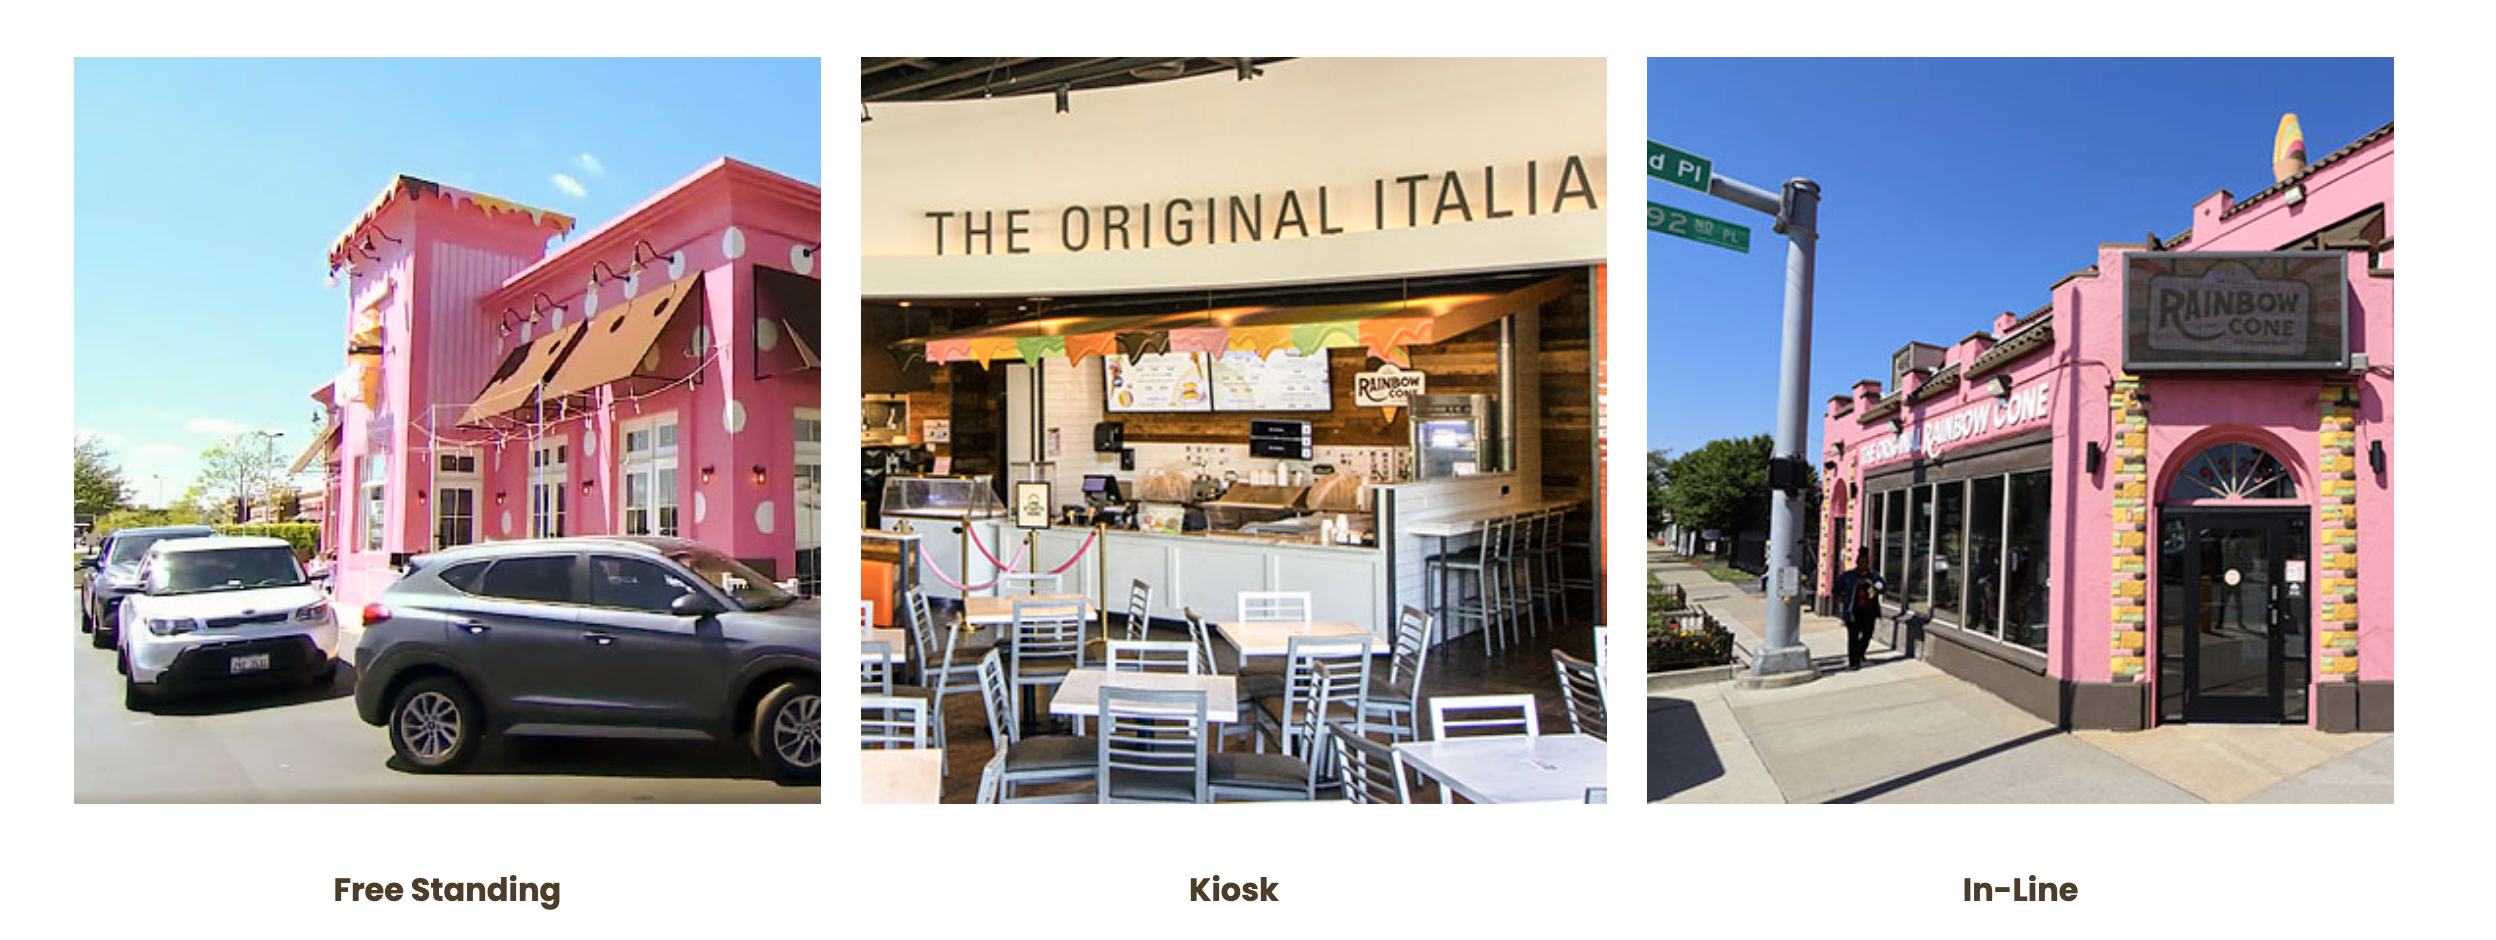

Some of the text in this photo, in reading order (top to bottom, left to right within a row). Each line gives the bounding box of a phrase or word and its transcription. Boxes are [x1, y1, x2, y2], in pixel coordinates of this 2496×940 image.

[1678, 160, 1702, 183] Pl
[925, 154, 1598, 256] THE ORIGINAL ITALIA
[2158, 287, 2299, 341] RAINBOW
[2228, 317, 2294, 337] CONE
[1359, 376, 1420, 402] RAINBOW
[1922, 401, 1991, 459] RAINBOW
[1993, 382, 2050, 429] CONE
